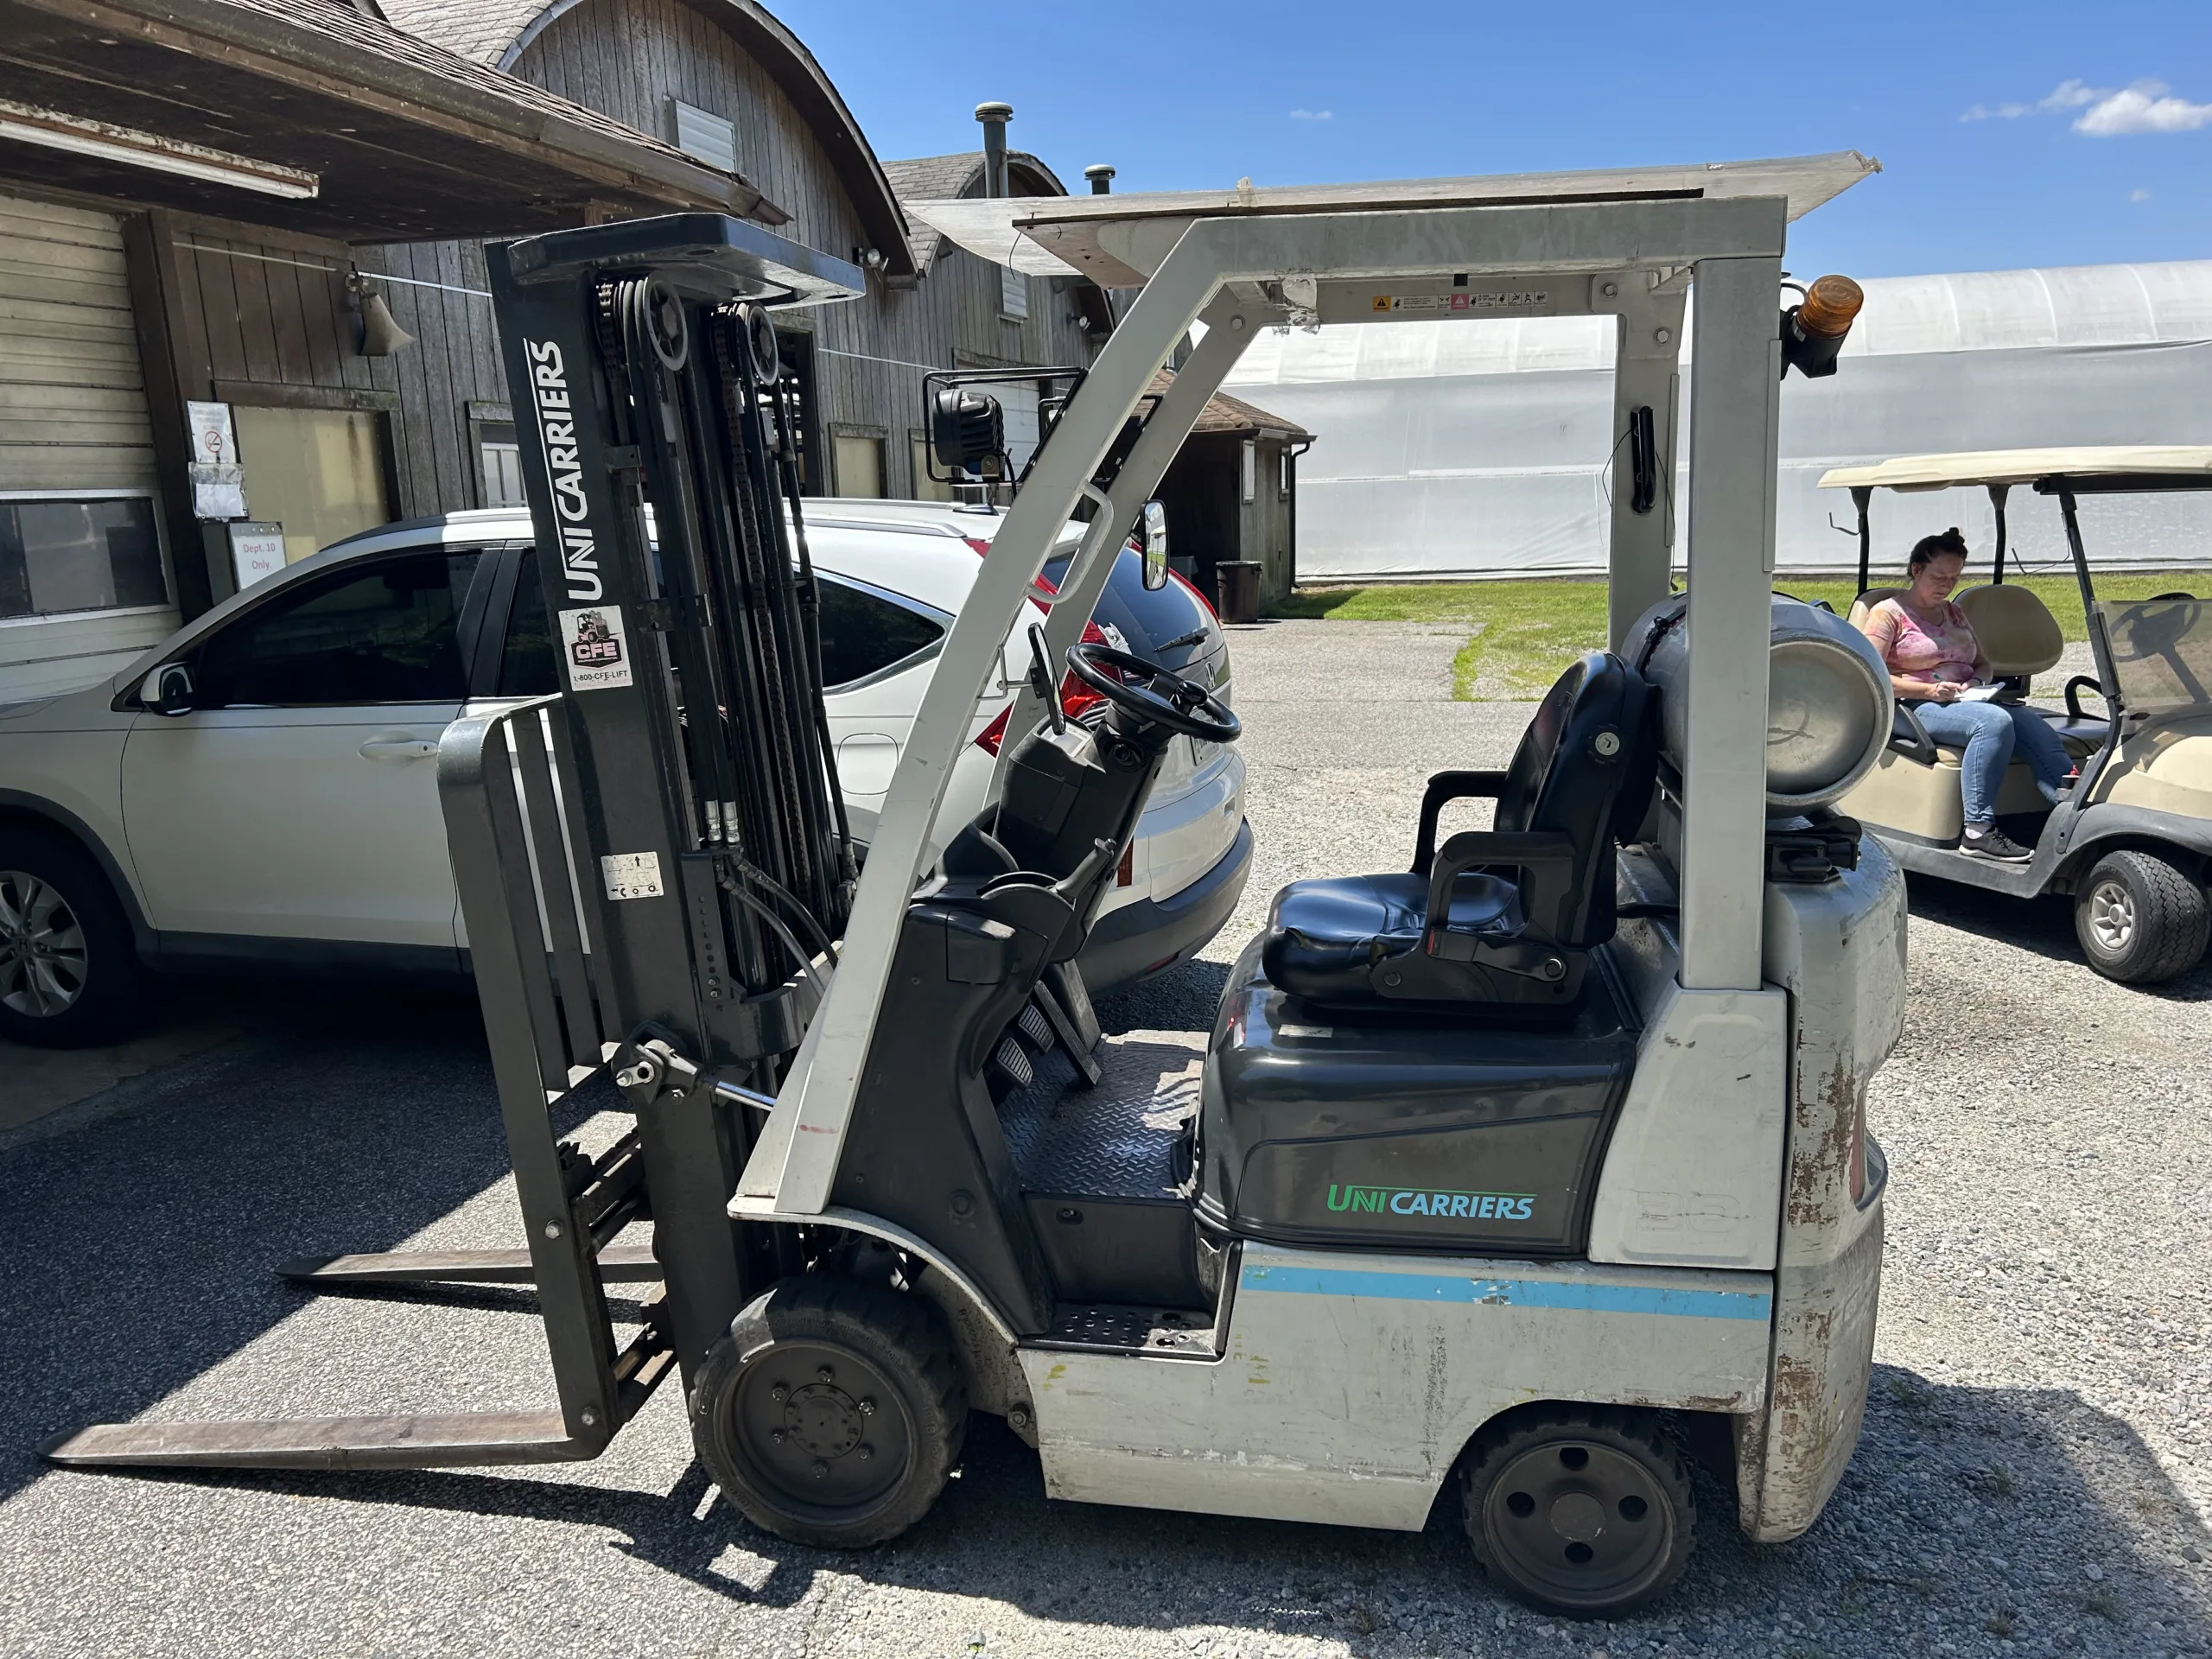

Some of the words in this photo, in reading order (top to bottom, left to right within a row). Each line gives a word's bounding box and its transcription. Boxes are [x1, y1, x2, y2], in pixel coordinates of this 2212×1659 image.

[524, 337, 603, 601] UNICARRIERS
[243, 543, 264, 554] Dept.
[266, 543, 276, 552] 10
[251, 560, 273, 571] Only.
[576, 642, 617, 658] CFE
[574, 671, 627, 682] 1-800-CFE-LIFT
[1327, 1185, 1538, 1220] UNICARRIERS
